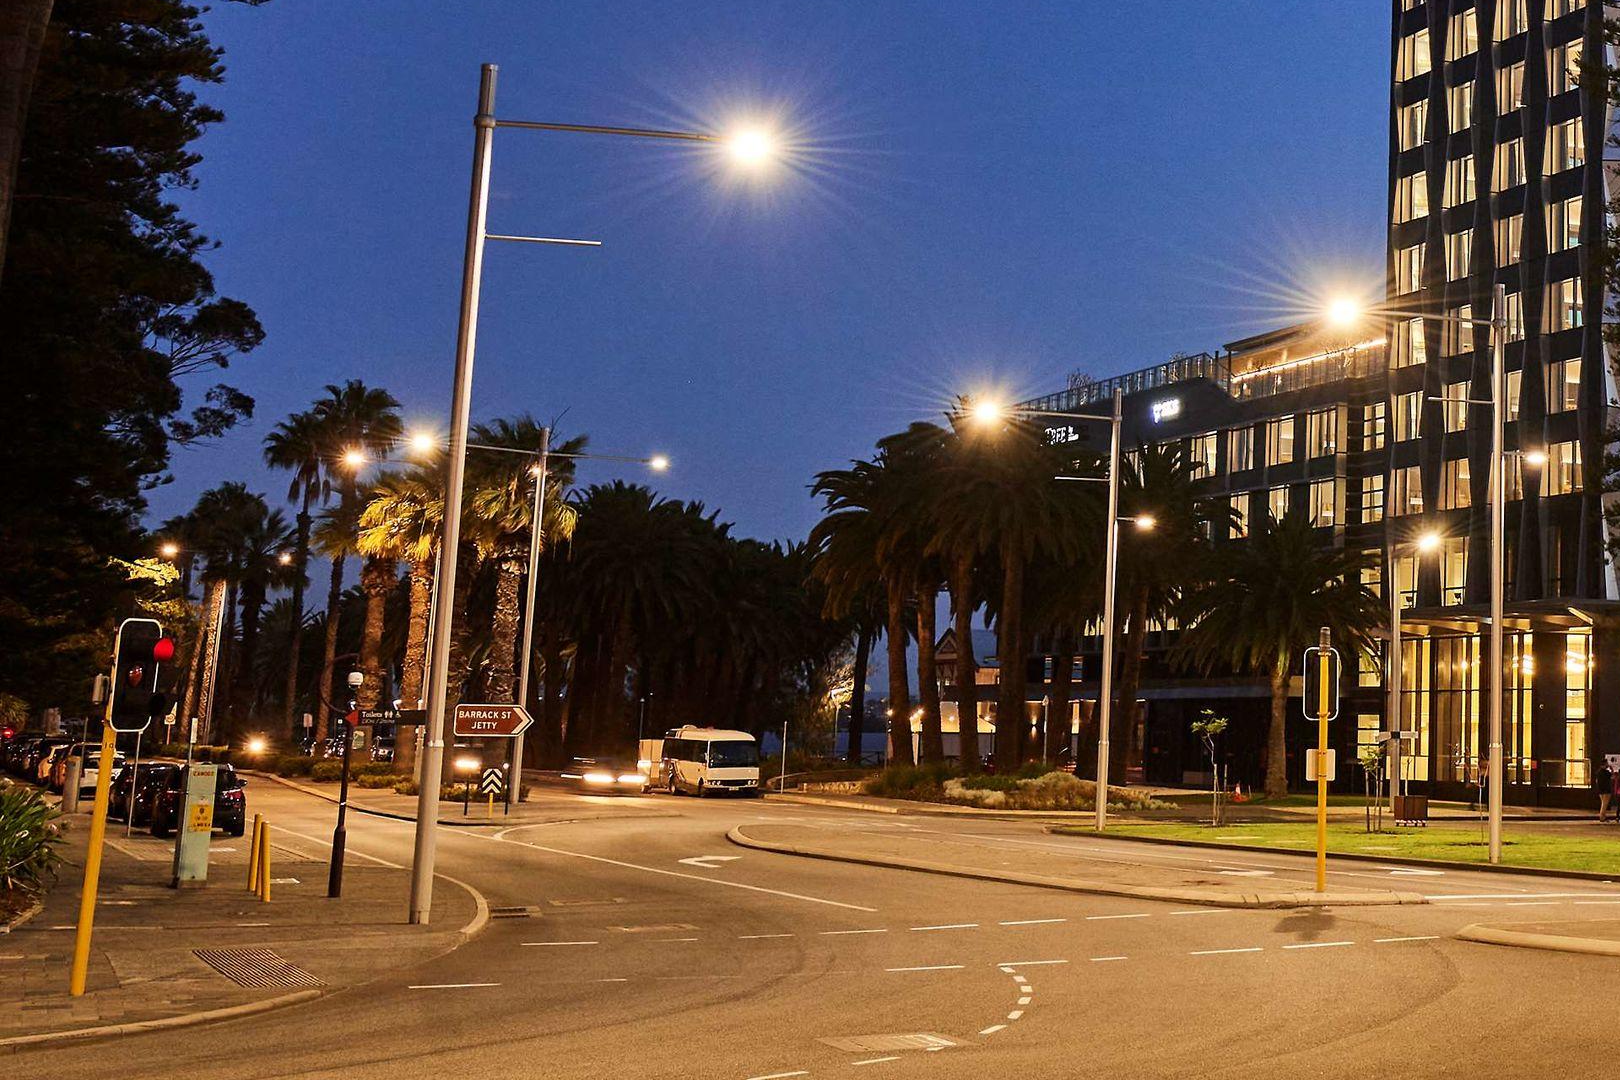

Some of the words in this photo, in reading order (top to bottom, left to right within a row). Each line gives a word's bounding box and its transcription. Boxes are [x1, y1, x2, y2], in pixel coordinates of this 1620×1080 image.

[458, 710, 499, 719] BARRACK
[501, 710, 512, 719] ST
[471, 722, 498, 730] JETTY
